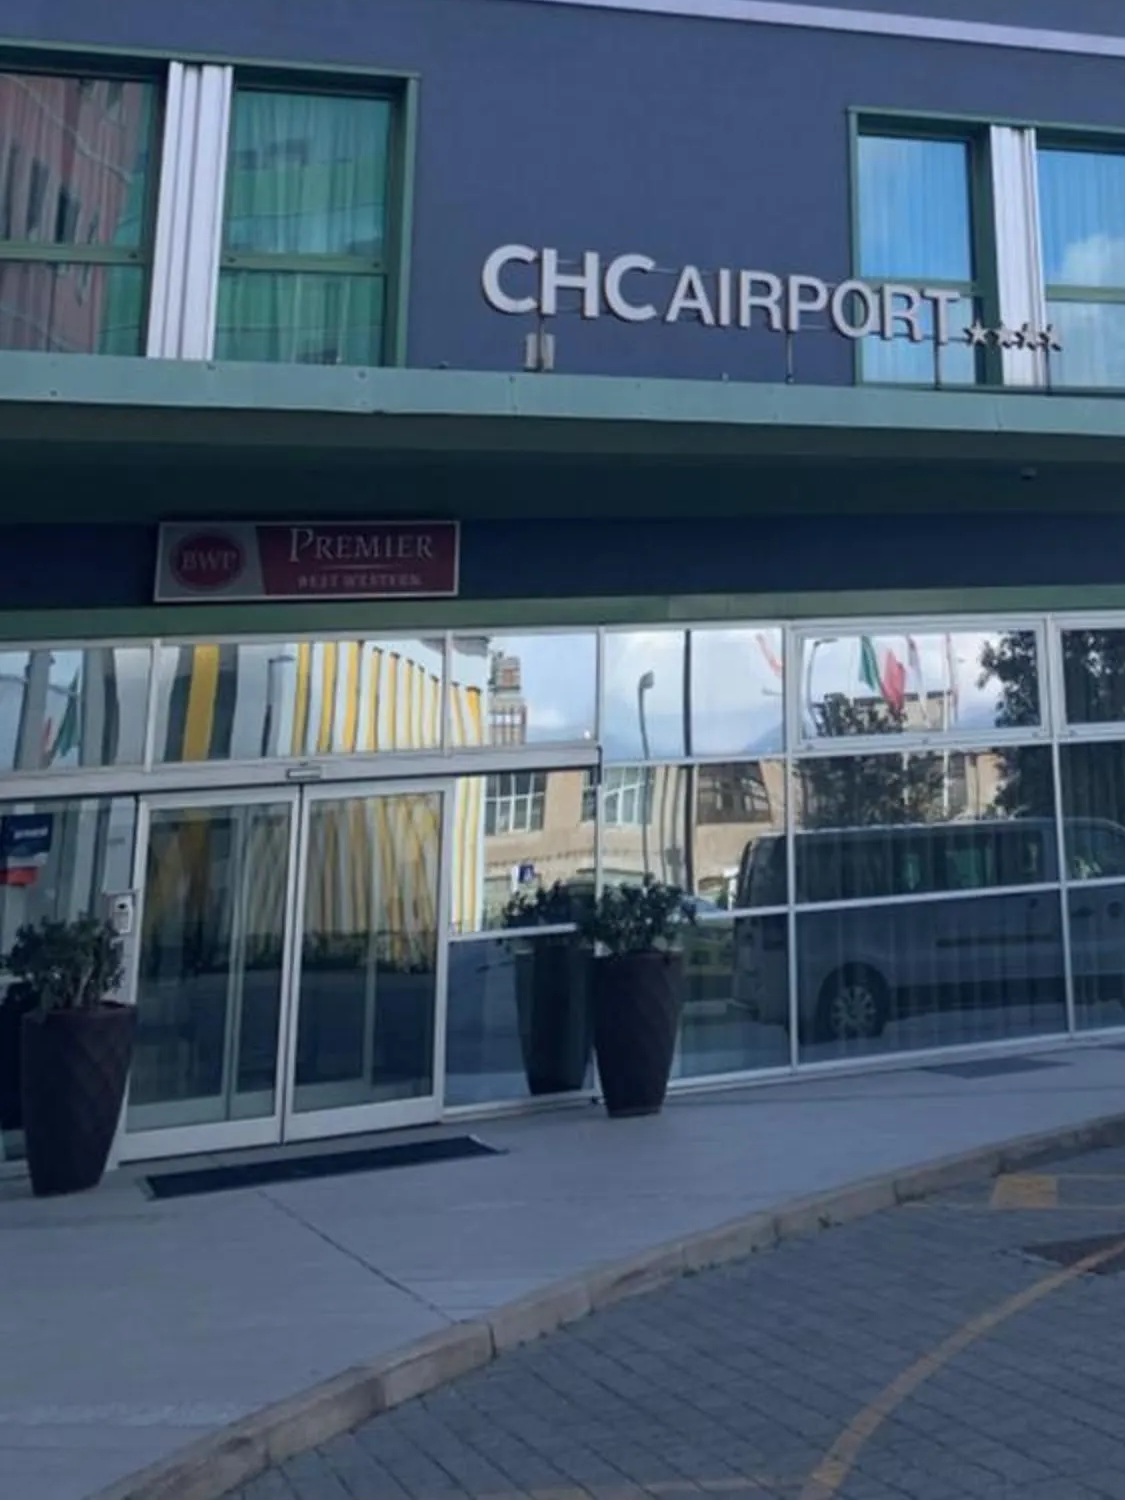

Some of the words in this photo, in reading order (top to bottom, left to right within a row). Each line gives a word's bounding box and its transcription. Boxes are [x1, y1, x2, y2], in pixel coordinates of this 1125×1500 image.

[481, 242, 656, 321] CHC
[666, 265, 961, 344] AIRPORT
[181, 550, 237, 572] BWP
[288, 527, 434, 564] PREMIER
